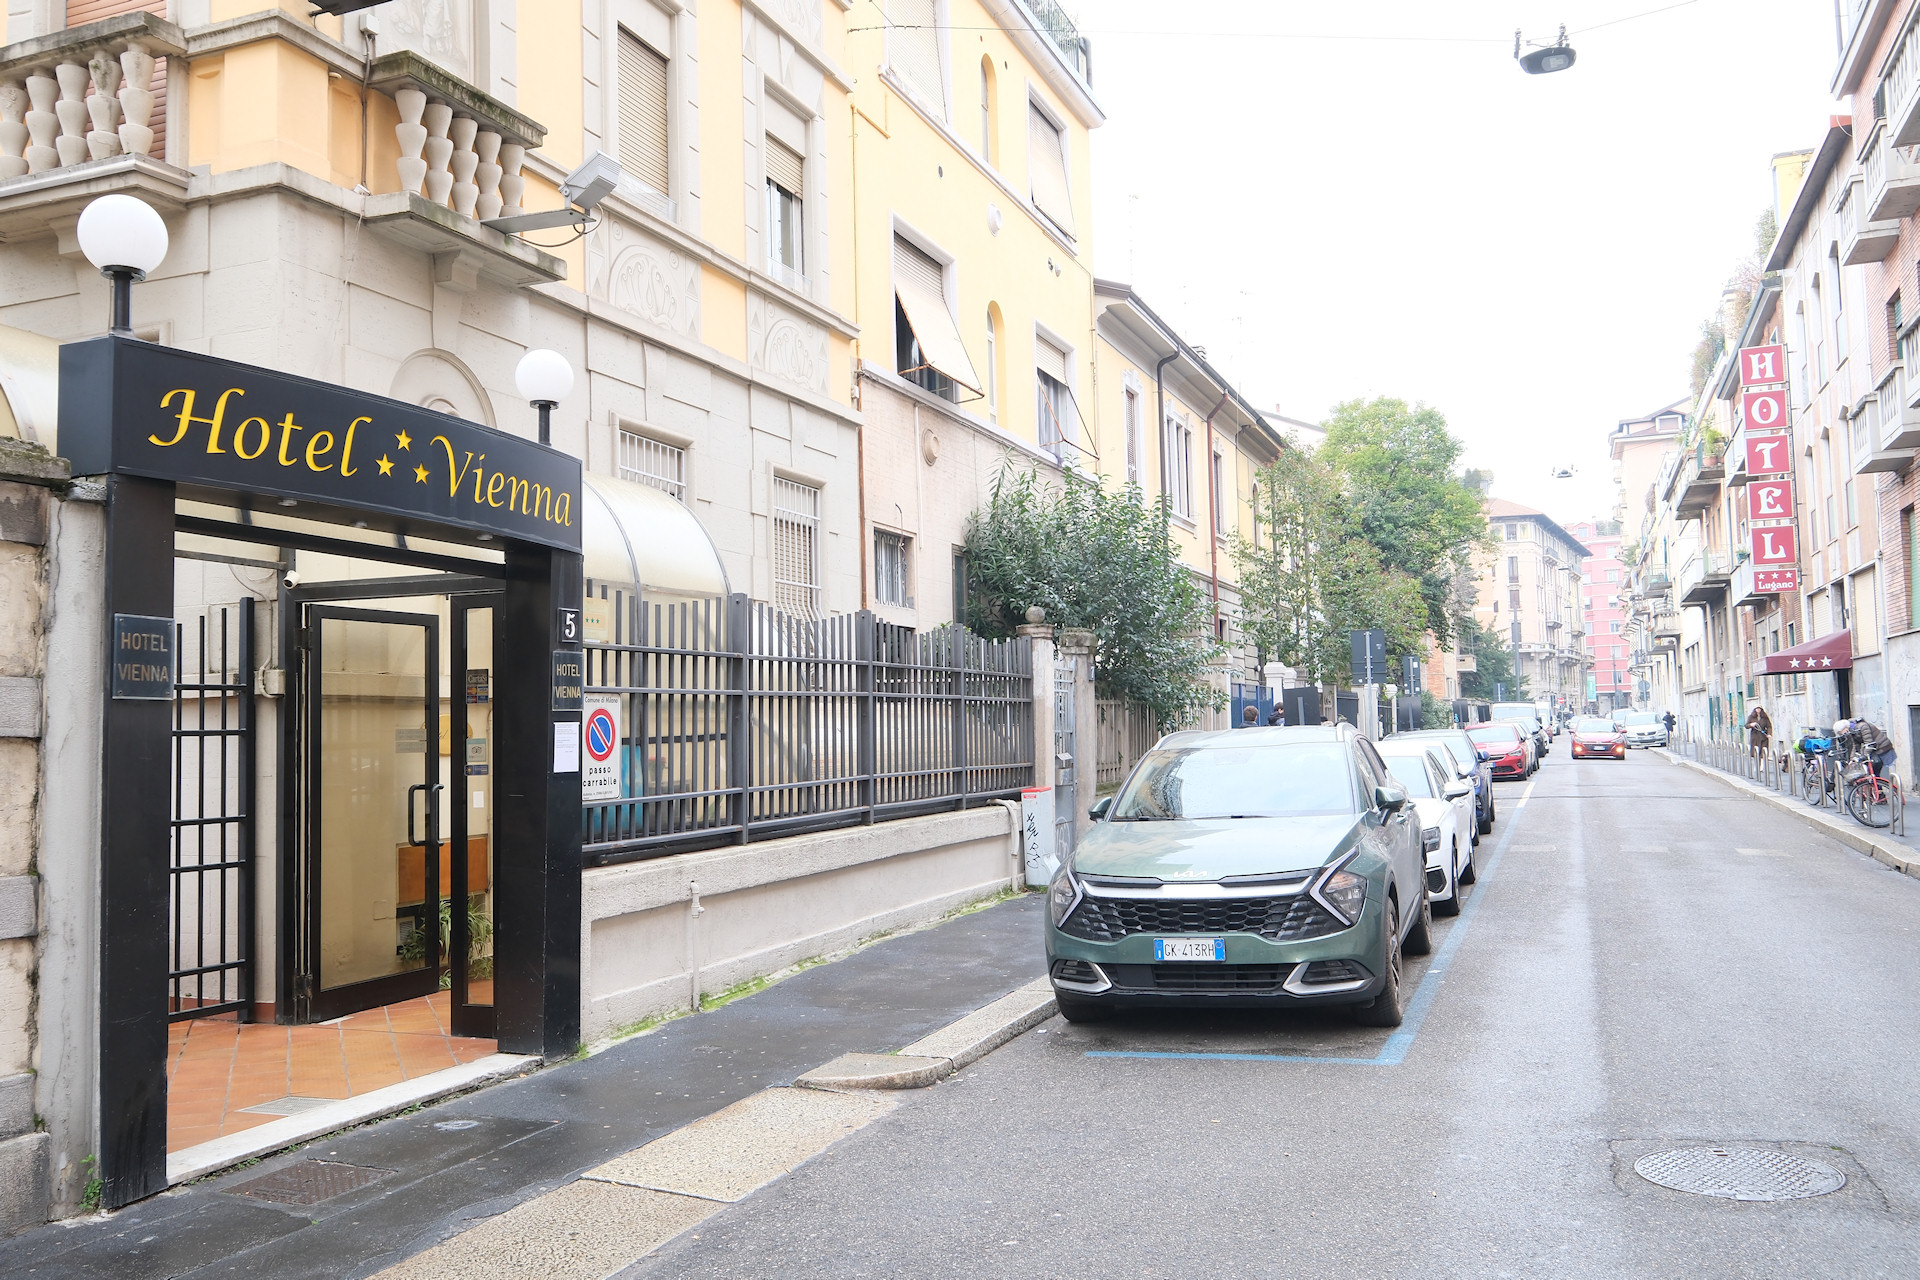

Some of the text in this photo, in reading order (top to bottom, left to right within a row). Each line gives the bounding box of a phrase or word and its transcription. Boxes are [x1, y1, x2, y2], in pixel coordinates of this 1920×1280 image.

[147, 387, 573, 528] Hotel Vienna
[1748, 352, 1786, 559] HOTEL
[1757, 581, 1794, 591] Lugano
[564, 612, 576, 638] 5
[120, 631, 168, 652] HOTEL
[118, 662, 169, 684] VIENNA
[556, 663, 580, 677] HOTEL
[555, 685, 581, 698] VIENNA
[585, 696, 600, 704] Comune
[606, 696, 618, 704] Milano
[588, 766, 612, 776] passo
[582, 777, 617, 787] carrabile
[1174, 870, 1208, 878] KIA
[1164, 943, 1177, 957] GK
[1182, 943, 1215, 957] 413RH
